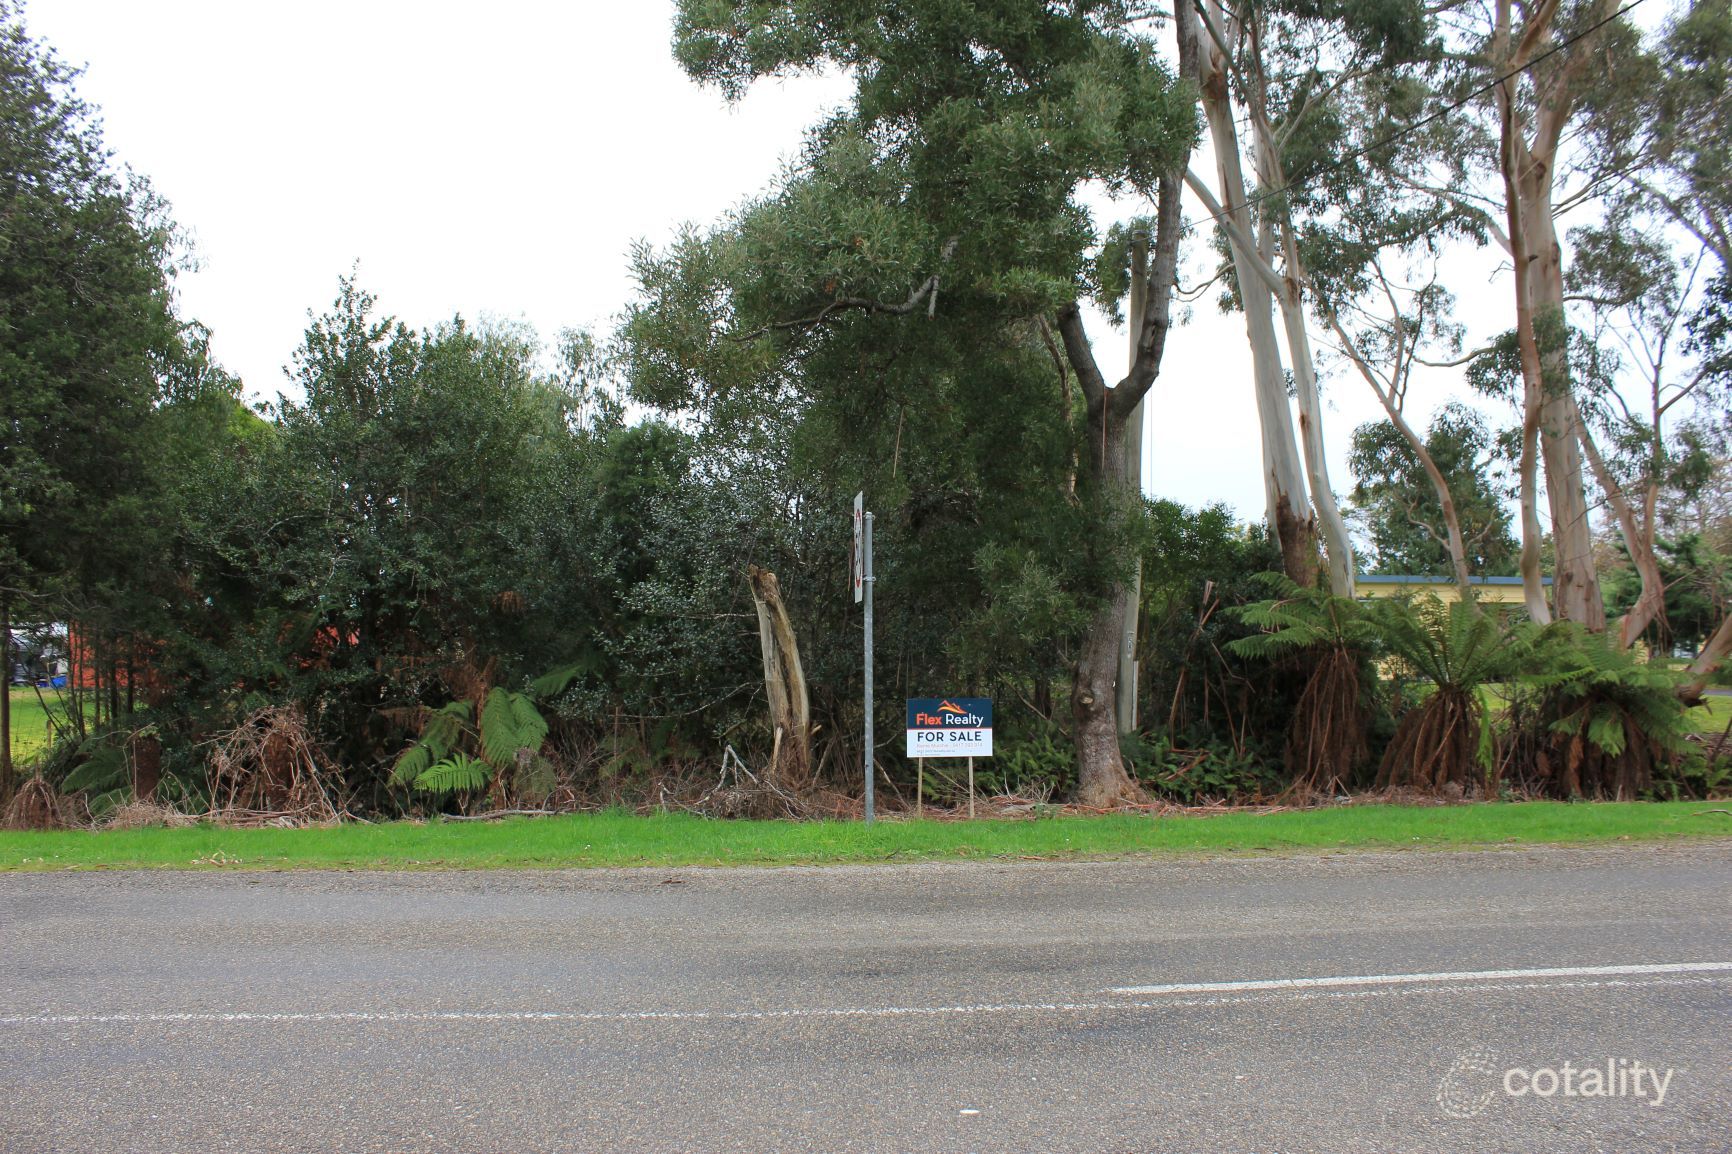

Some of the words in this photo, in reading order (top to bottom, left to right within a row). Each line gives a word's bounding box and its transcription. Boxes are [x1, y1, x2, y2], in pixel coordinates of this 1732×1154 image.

[916, 713, 942, 725] Flex
[945, 713, 984, 728] Realty
[917, 732, 944, 742] FOR
[949, 731, 982, 741] SALE
